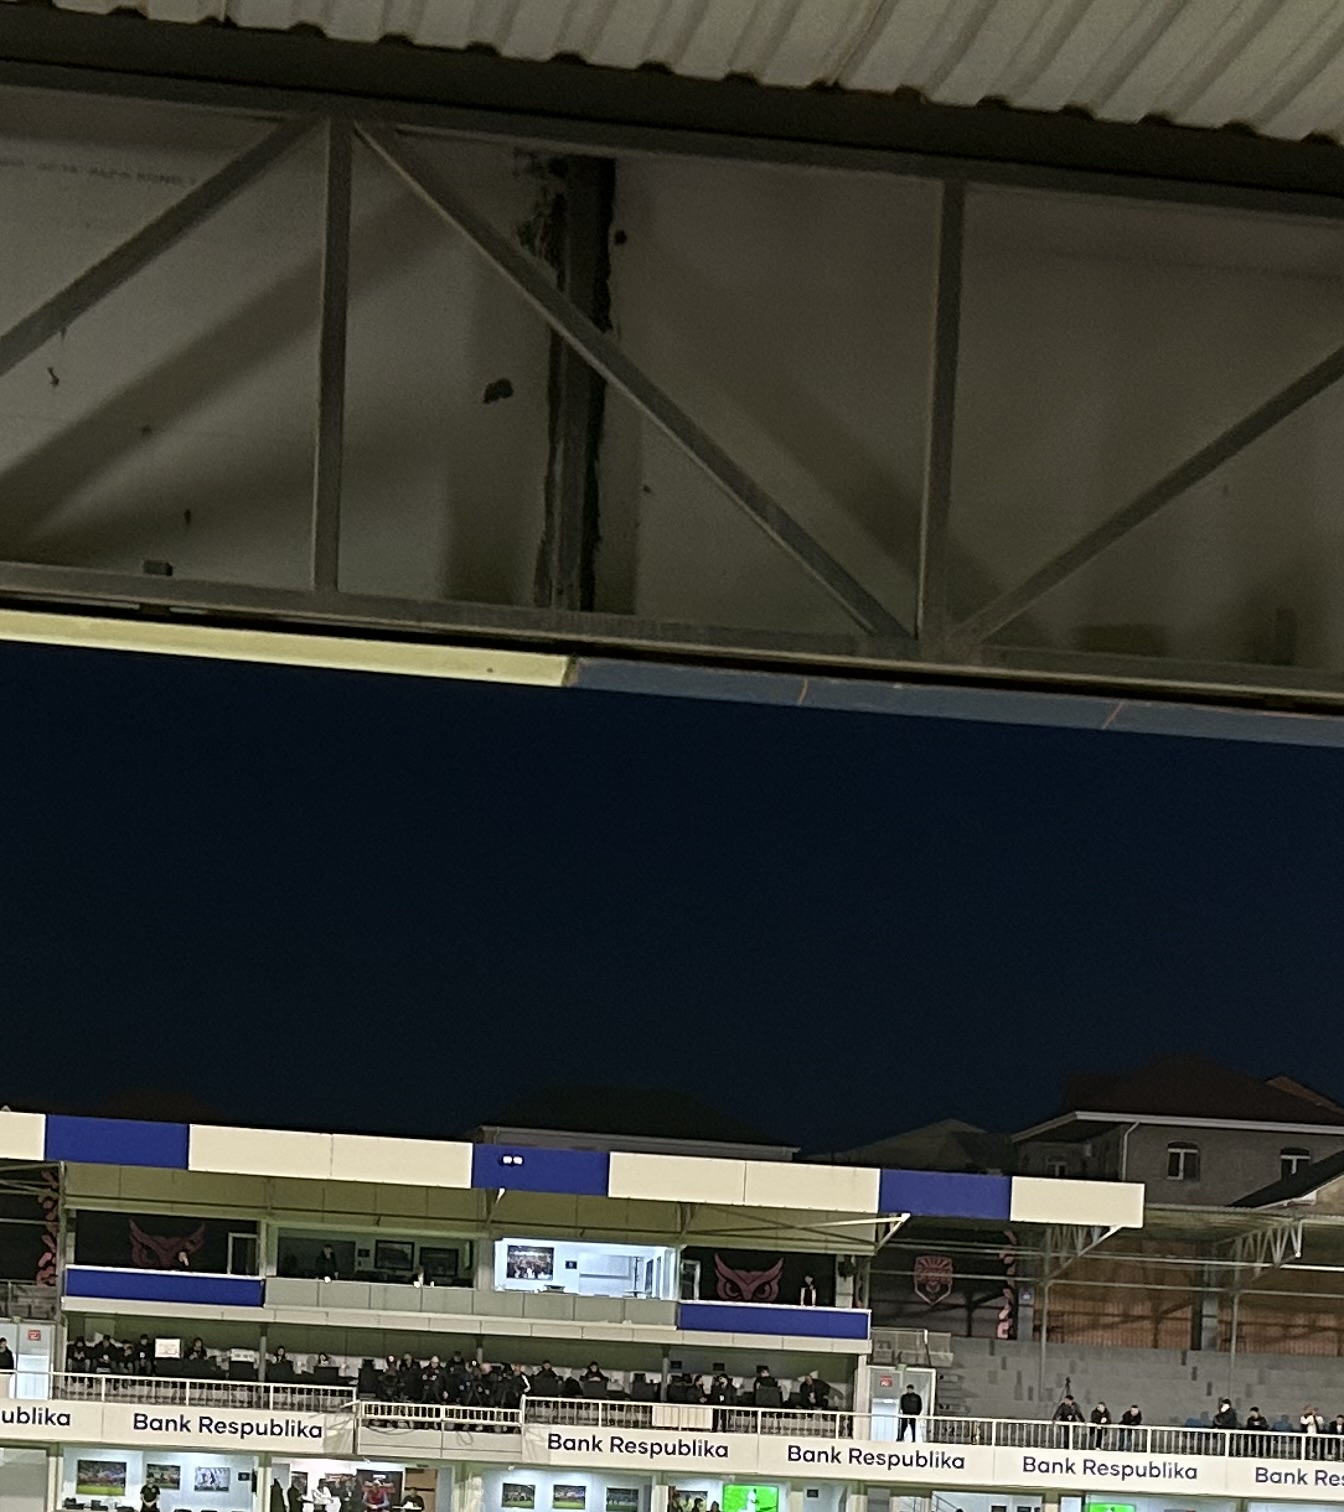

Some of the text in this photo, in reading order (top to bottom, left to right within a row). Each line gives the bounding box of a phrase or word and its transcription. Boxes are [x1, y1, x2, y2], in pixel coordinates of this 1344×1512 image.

[134, 1413, 323, 1440] Bank Respublika
[548, 1433, 729, 1460] Bank Respublika
[788, 1445, 966, 1471] Bank Respublika
[1023, 1456, 1198, 1482] Bank Respublika
[1256, 1467, 1308, 1486] Bank
